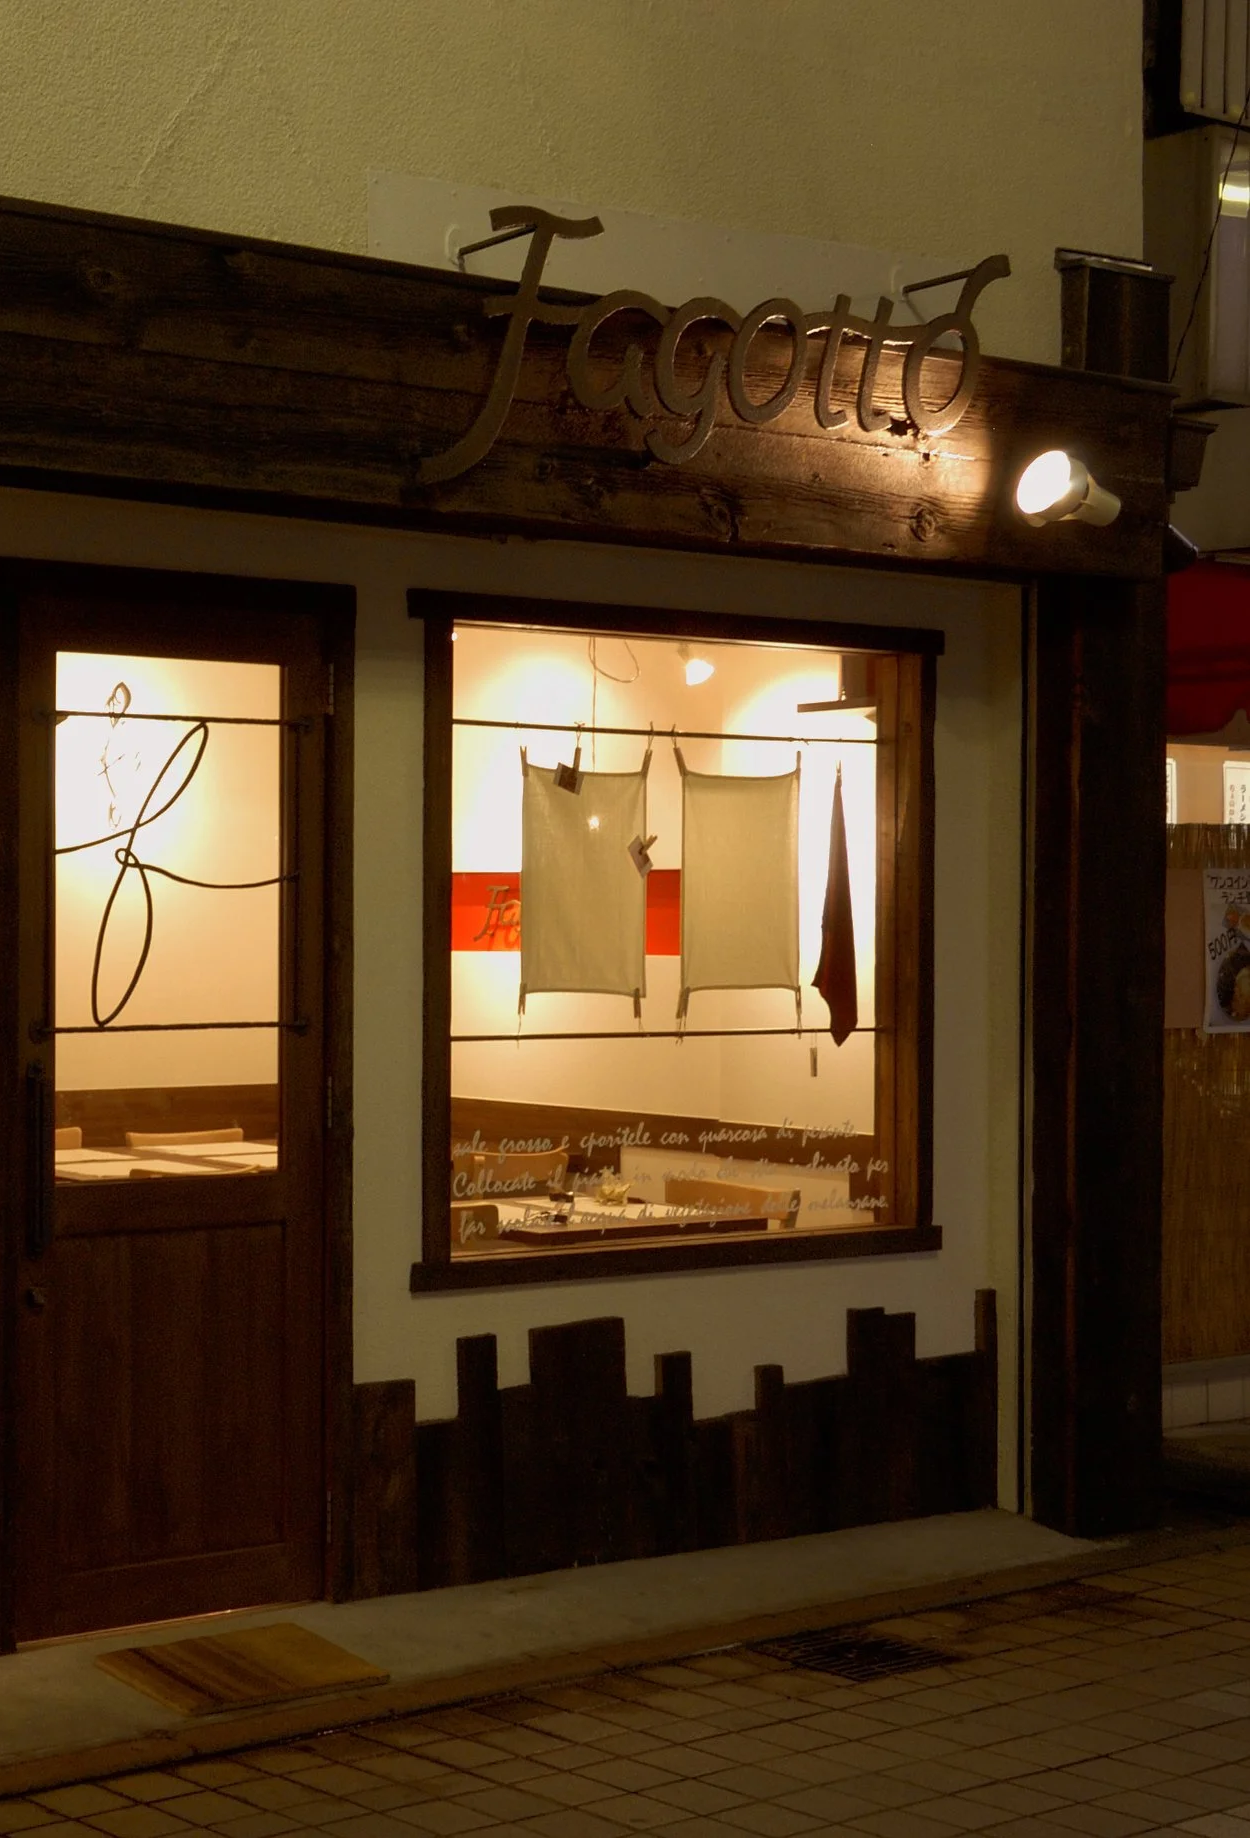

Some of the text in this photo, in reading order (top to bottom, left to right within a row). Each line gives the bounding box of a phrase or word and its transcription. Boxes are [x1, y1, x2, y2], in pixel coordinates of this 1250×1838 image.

[416, 205, 1010, 486] Fagotto
[661, 1130, 690, 1146] con
[776, 1118, 796, 1140] di
[453, 1167, 537, 1198] Collocate
[546, 1163, 563, 1188] il
